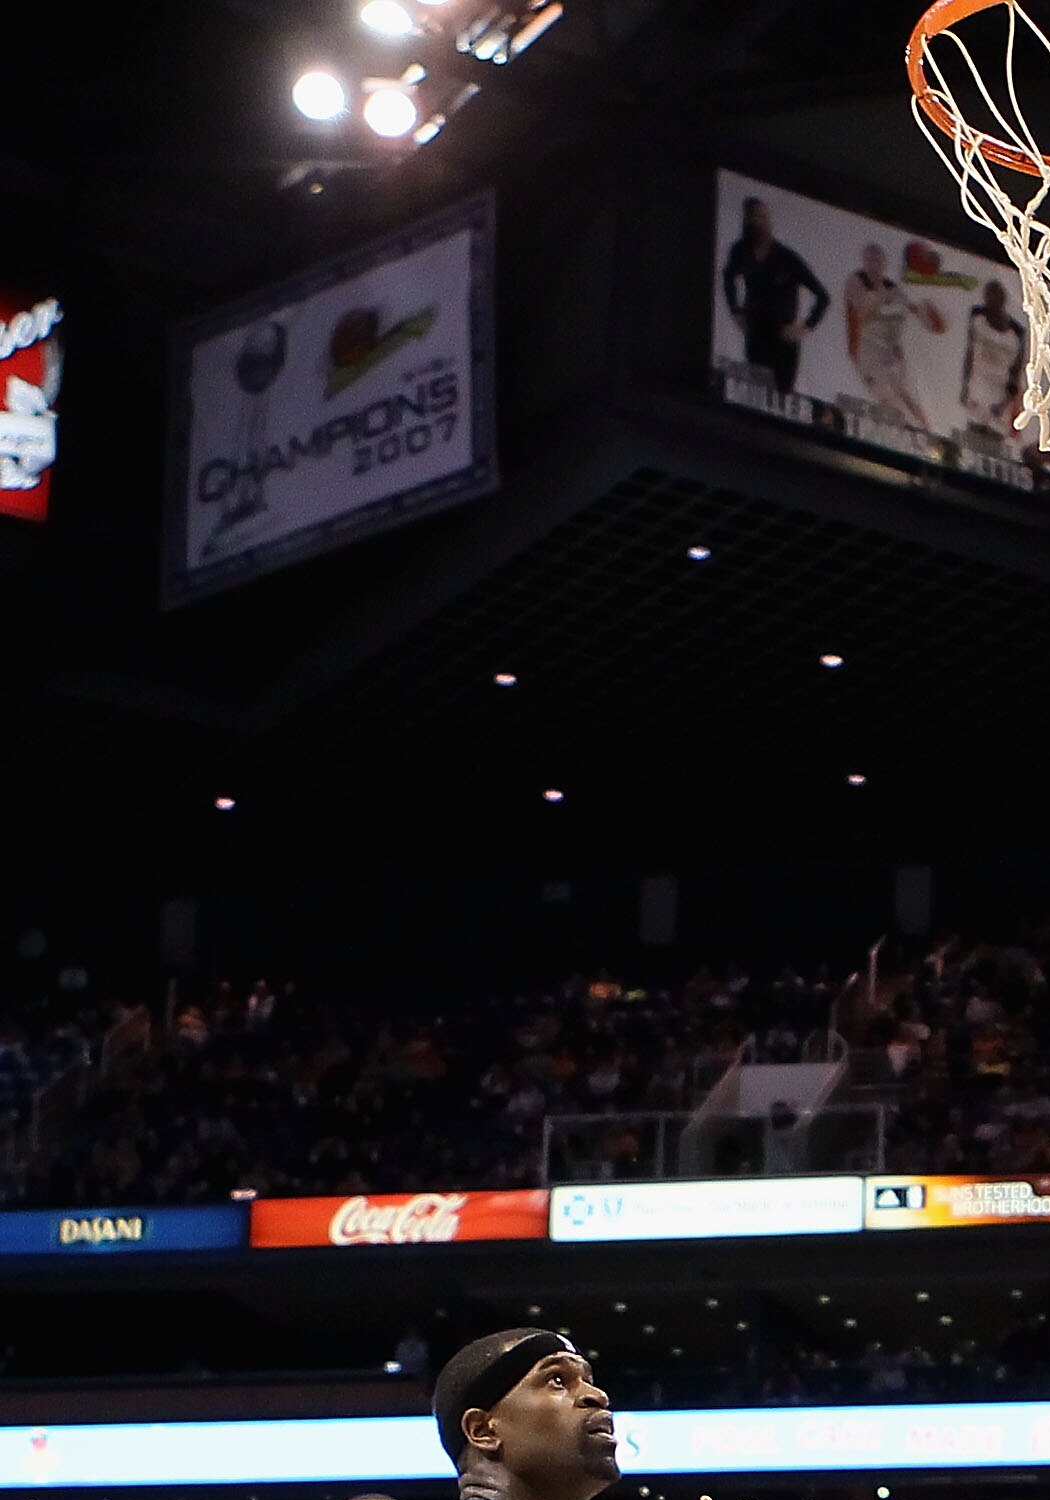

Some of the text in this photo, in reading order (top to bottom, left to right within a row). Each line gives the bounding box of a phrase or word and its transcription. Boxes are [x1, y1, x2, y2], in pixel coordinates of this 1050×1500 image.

[200, 373, 458, 503] CHAMPIONS
[352, 413, 458, 477] 2007
[59, 1217, 142, 1245] DASANI
